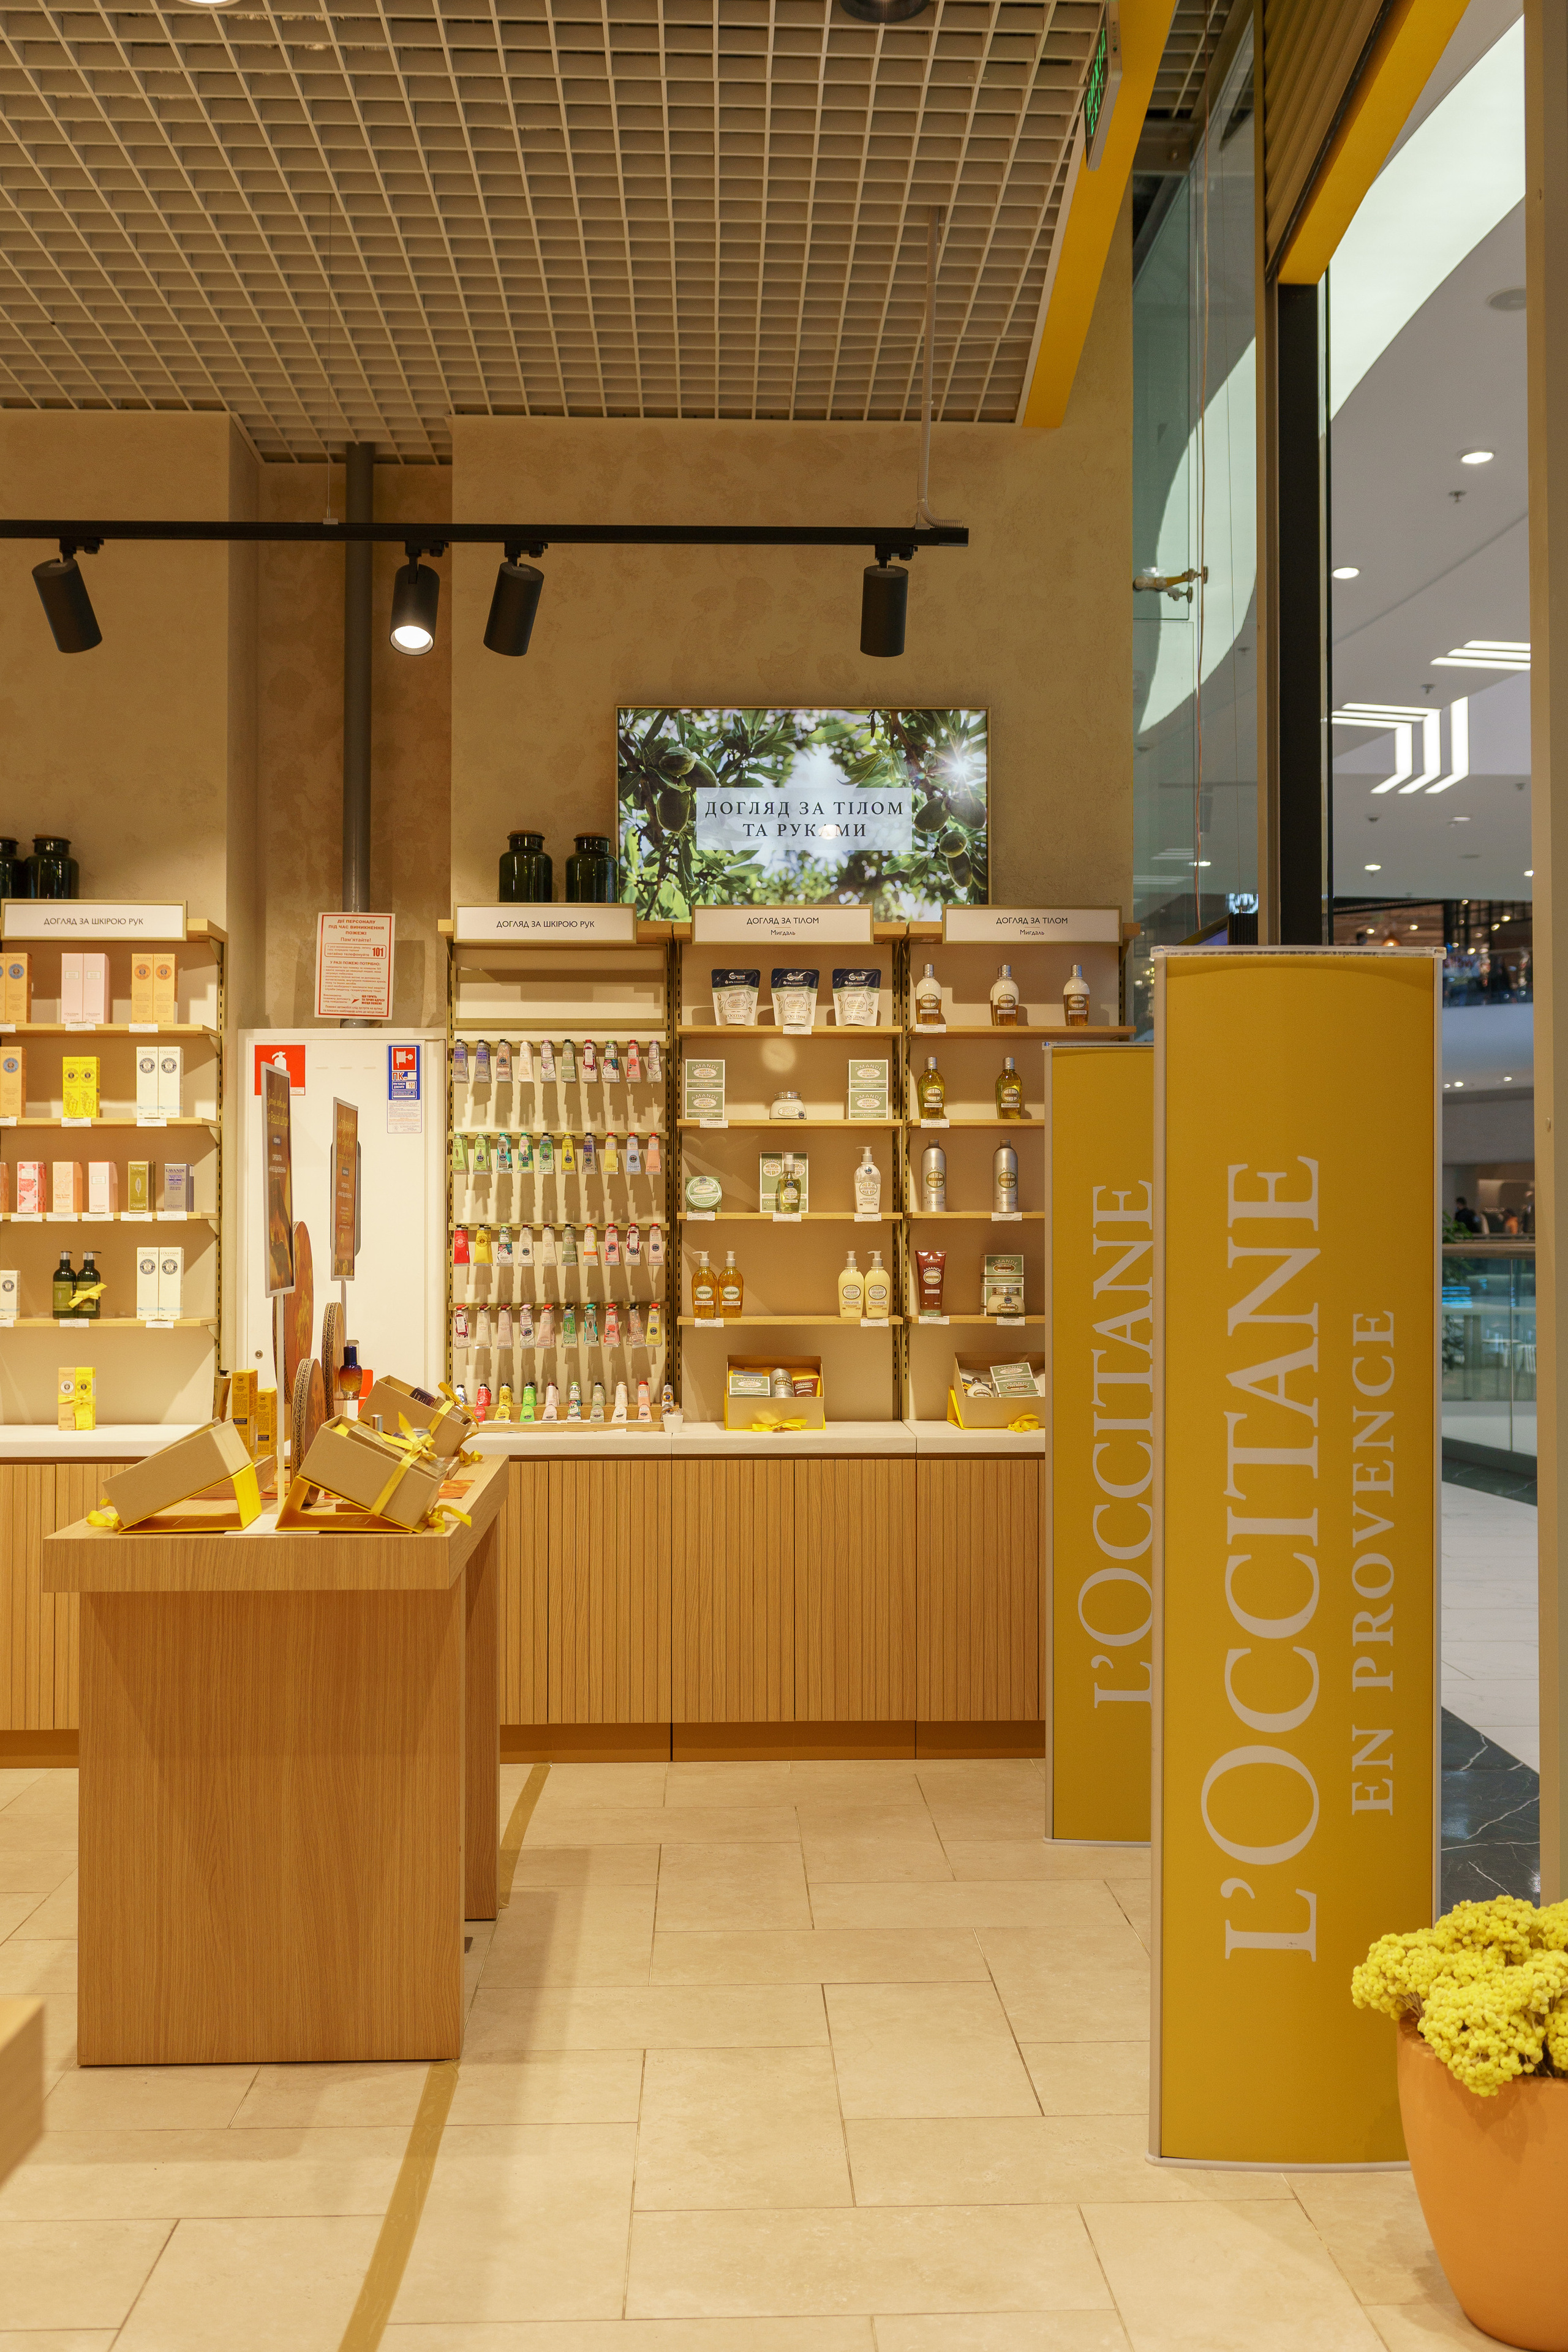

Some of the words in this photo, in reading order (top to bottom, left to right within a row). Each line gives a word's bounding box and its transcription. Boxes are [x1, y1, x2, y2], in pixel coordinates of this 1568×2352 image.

[1087, 28, 1106, 121] ВИХІД
[1091, 71, 1104, 135] EXIT
[705, 801, 790, 818] ДОГЛЯД
[799, 801, 824, 815] ЗА
[833, 801, 903, 815] ТІЛОМ
[742, 823, 768, 837] ТА
[372, 947, 383, 957] 101
[1078, 1180, 1153, 1708] L'OCCITANE
[1351, 1310, 1395, 1691] PROVENCE
[1200, 1155, 1321, 1962] L'OCCITANE
[1352, 1725, 1393, 1815] EN
